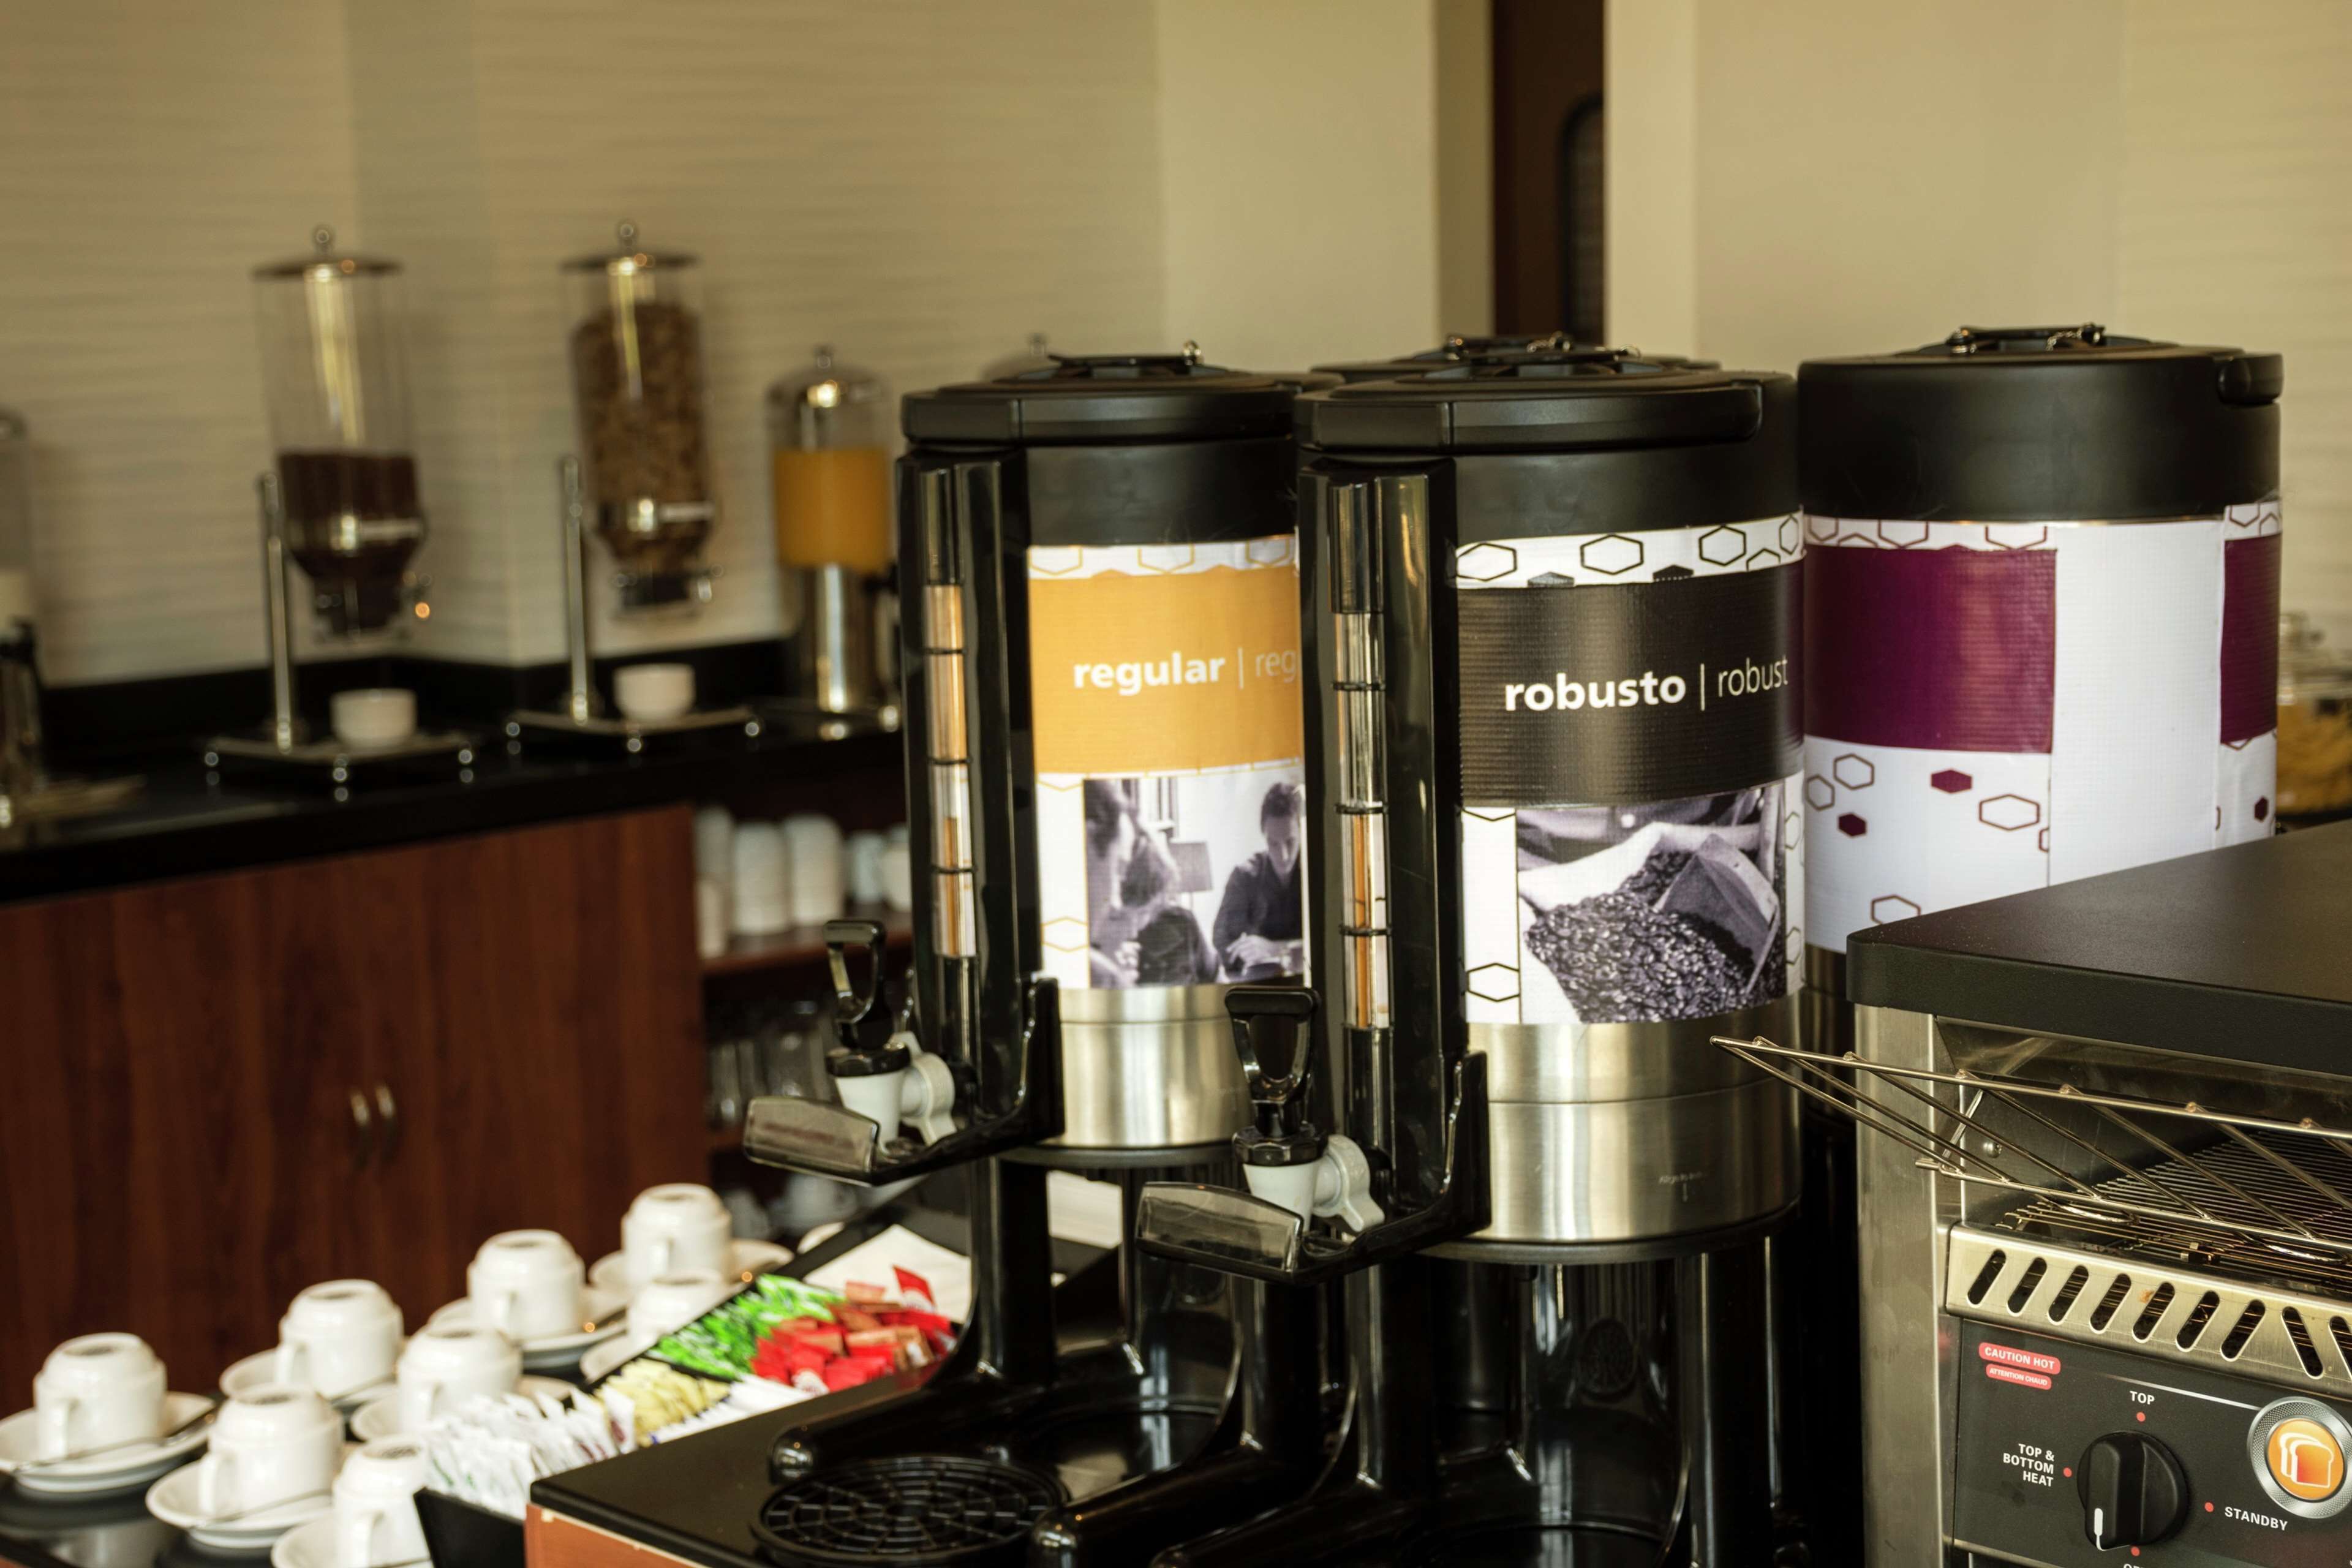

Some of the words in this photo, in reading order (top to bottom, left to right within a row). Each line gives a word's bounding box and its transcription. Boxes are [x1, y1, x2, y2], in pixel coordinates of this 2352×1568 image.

[1073, 650, 1226, 696] regular
[1505, 671, 1687, 711] robusto
[1984, 1346, 2031, 1365] CAUTION
[2033, 1357, 2055, 1370] HOT
[1989, 1367, 2024, 1381] ATTENTION
[2025, 1375, 2048, 1386] CHAUD
[2129, 1390, 2155, 1405] TOP
[2003, 1452, 2054, 1475] BOTTOM
[2018, 1443, 2043, 1458] TOP
[2045, 1450, 2055, 1461] &
[2022, 1470, 2054, 1487] HEAT
[2224, 1506, 2288, 1531] STANDBY
